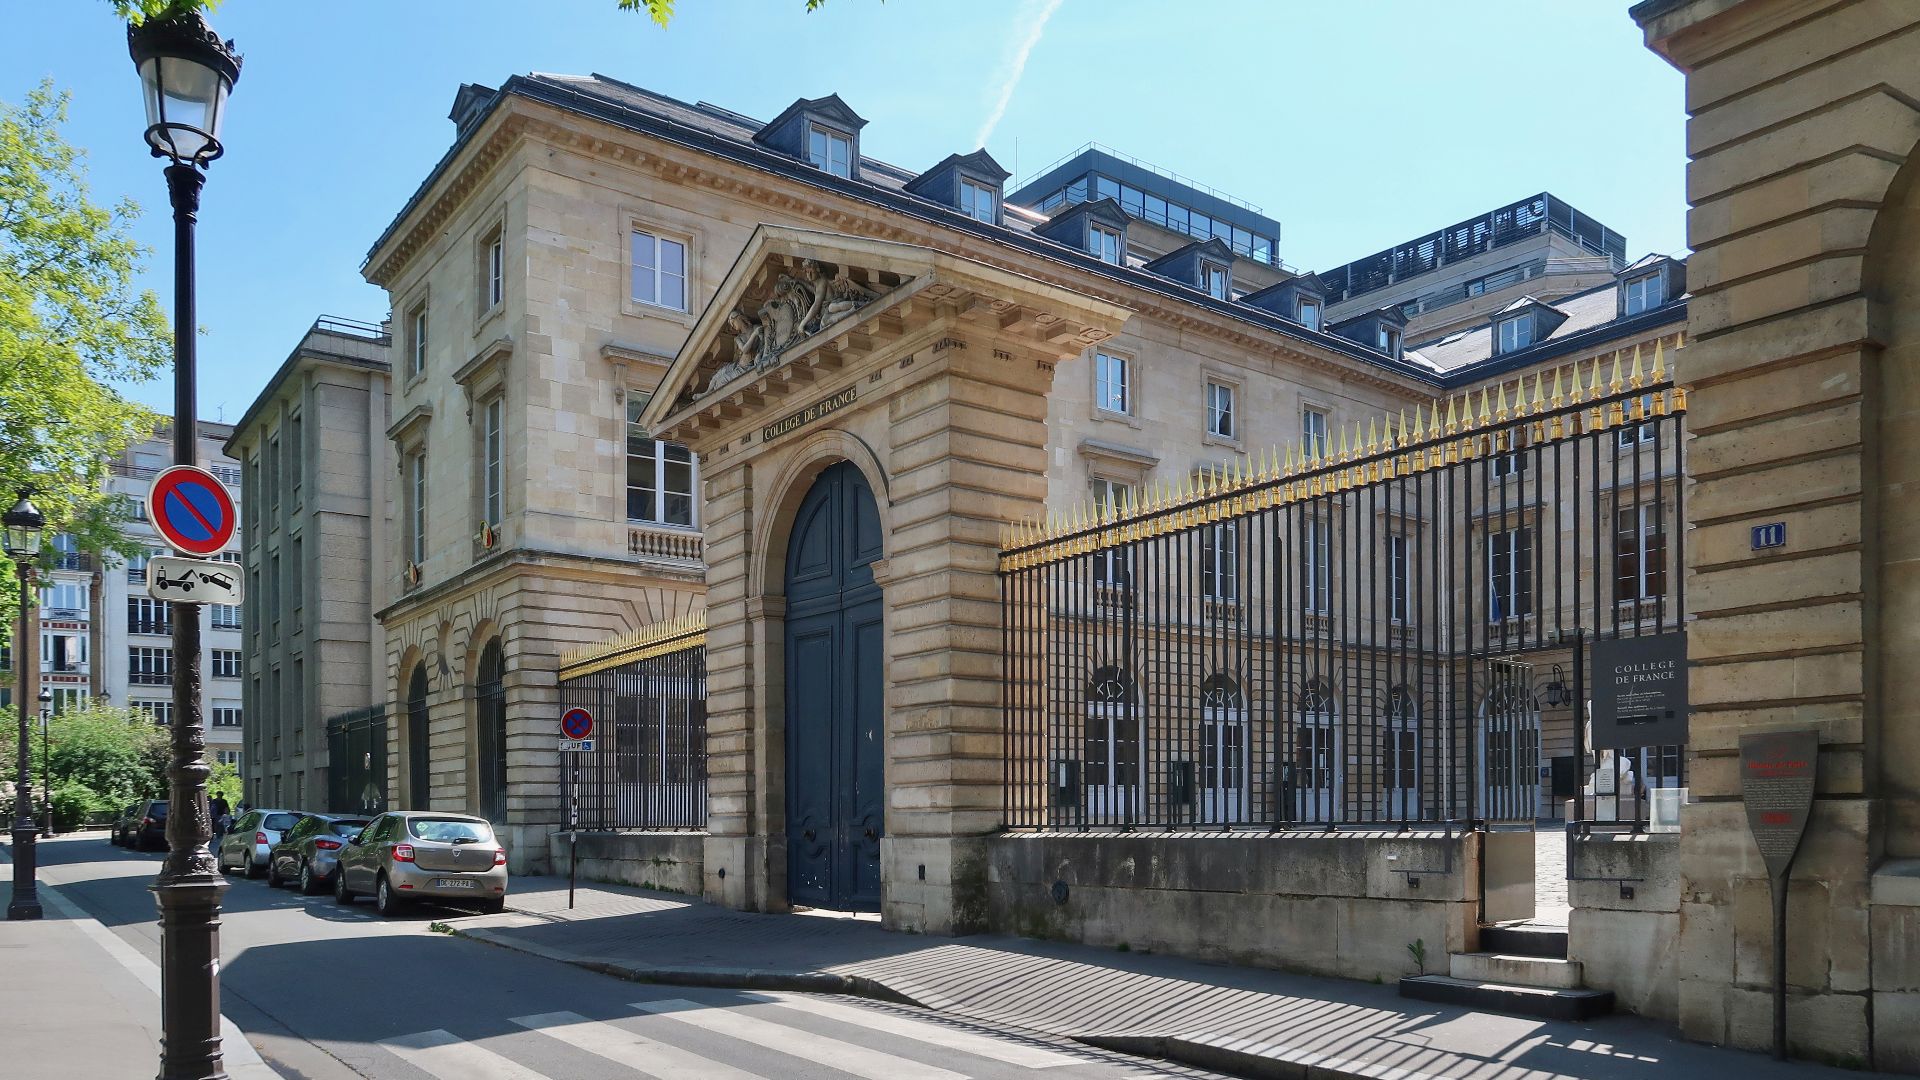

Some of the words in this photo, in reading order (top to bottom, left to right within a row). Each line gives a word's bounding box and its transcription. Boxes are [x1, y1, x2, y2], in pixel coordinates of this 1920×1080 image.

[765, 415, 800, 439] COLLEGE
[804, 407, 816, 423] DE
[819, 388, 856, 415] FRANCE
[1760, 526, 1776, 545] 11
[1615, 660, 1675, 673] COLLEGE
[1615, 675, 1629, 685] DE
[1633, 671, 1675, 683] FRANCE
